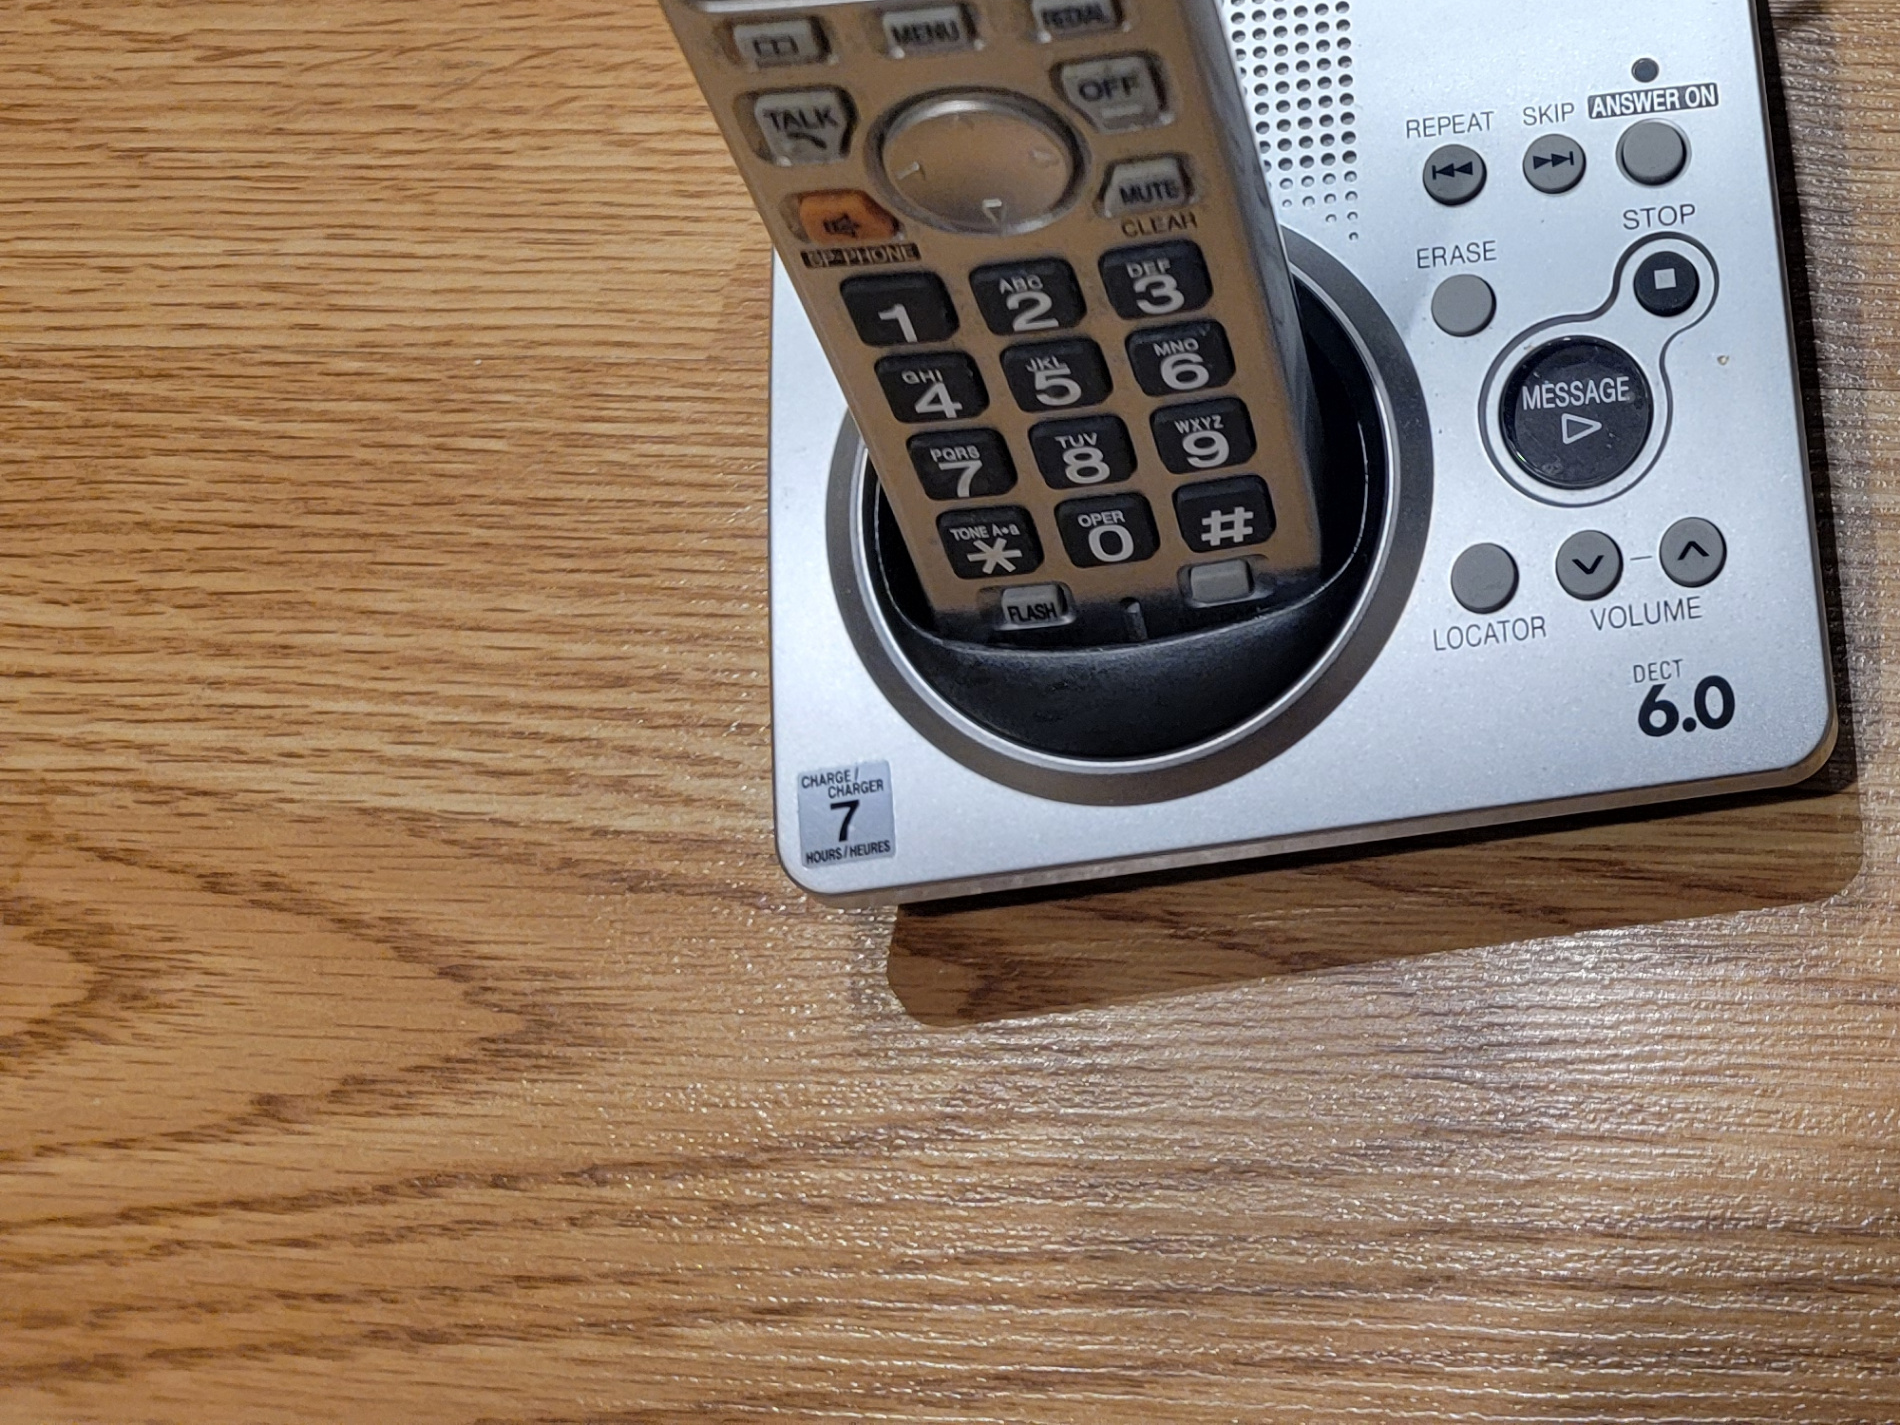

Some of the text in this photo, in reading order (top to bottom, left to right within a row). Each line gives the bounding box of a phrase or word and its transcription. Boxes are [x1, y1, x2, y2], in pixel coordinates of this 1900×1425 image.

[891, 18, 960, 45] MENU
[1077, 75, 1139, 101] OFF
[1591, 84, 1717, 118] ANSWER ON
[764, 106, 838, 132] TALK
[1405, 111, 1495, 139] REPEAT
[1522, 102, 1575, 126] SKIP
[1120, 180, 1181, 204] MUTE
[1122, 211, 1198, 237] CLEAR
[1622, 203, 1697, 231] STOP
[1416, 240, 1498, 269] ERASE
[1125, 259, 1171, 279] DEF
[999, 276, 1044, 295] ABC
[1134, 274, 1186, 315] 3
[878, 303, 917, 343] 1
[1005, 291, 1060, 332] 2
[1153, 337, 1200, 357] MNO
[902, 368, 943, 386] GHI
[1026, 355, 1068, 373] JKL
[1159, 352, 1210, 392] 6
[914, 382, 962, 419] 4
[1033, 366, 1083, 407] 5
[1522, 376, 1630, 411] MESSAGE
[1174, 414, 1225, 435] WXYZ
[929, 444, 981, 463] PQRS
[1056, 431, 1098, 450] TUV
[1180, 429, 1230, 469] 9
[938, 458, 984, 498] 7
[1062, 446, 1111, 486] 8
[1078, 509, 1126, 529] OPER
[1200, 505, 1255, 547] #
[949, 525, 990, 542] TONE
[1087, 523, 1135, 563] 0
[1007, 601, 1058, 623] FLASH
[1590, 596, 1703, 631] VOLUME
[1432, 615, 1547, 652] LOCATOR
[1633, 659, 1684, 684] DECT
[1638, 675, 1736, 737] 6.0
[827, 778, 885, 800] CHARGER
[829, 798, 860, 843] 7
